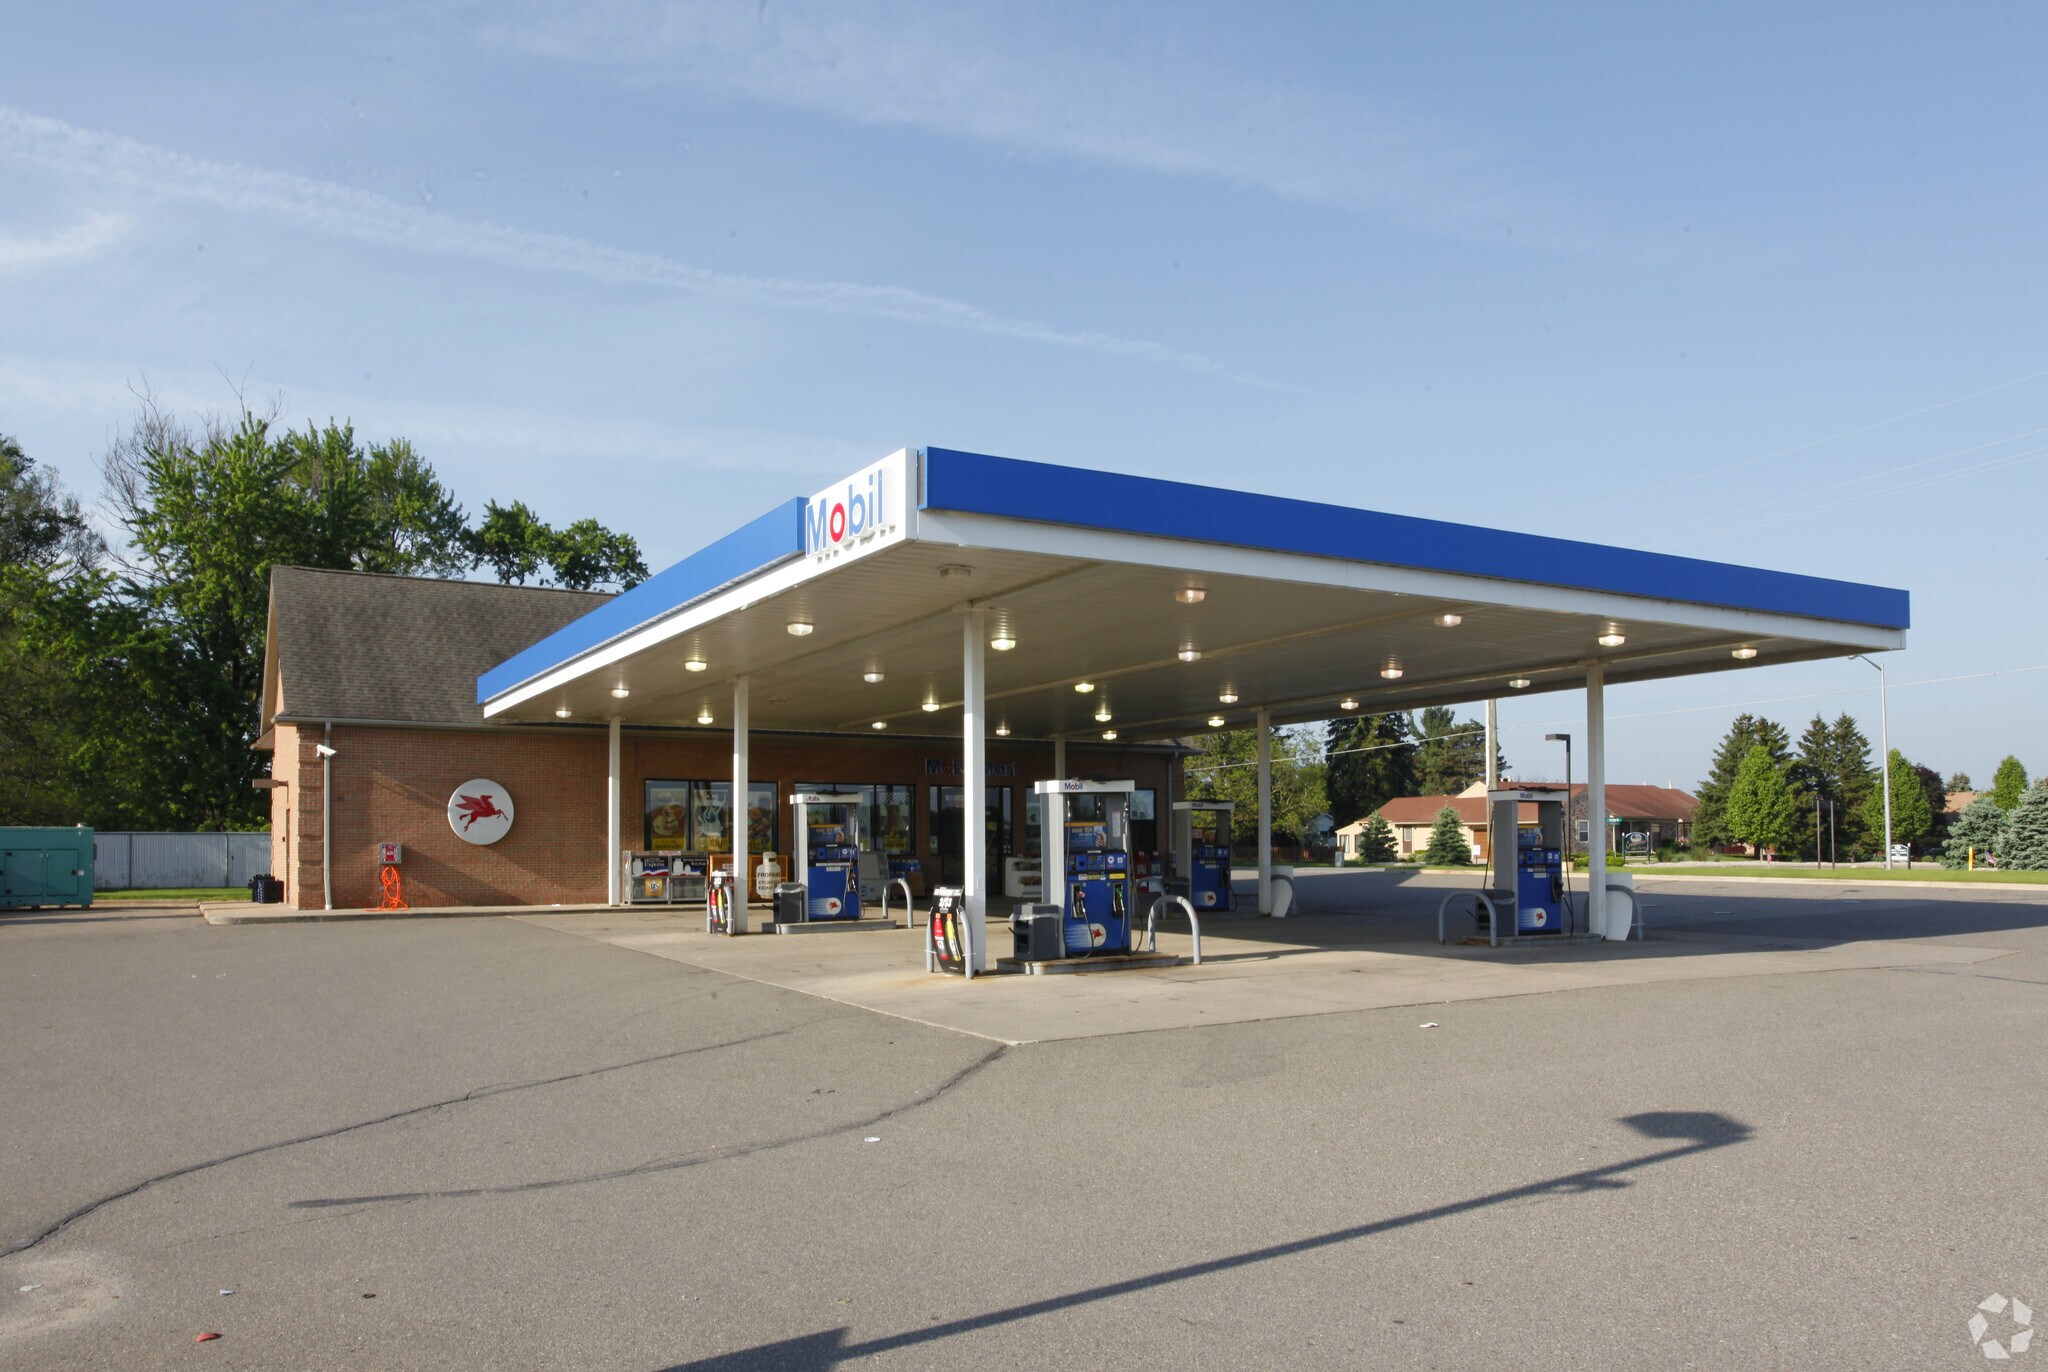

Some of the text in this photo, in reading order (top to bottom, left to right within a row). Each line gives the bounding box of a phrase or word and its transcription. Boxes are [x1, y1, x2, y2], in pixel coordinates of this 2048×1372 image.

[806, 468, 883, 557] Mobil
[924, 758, 964, 776] Mob
[1064, 782, 1084, 791] Mobil
